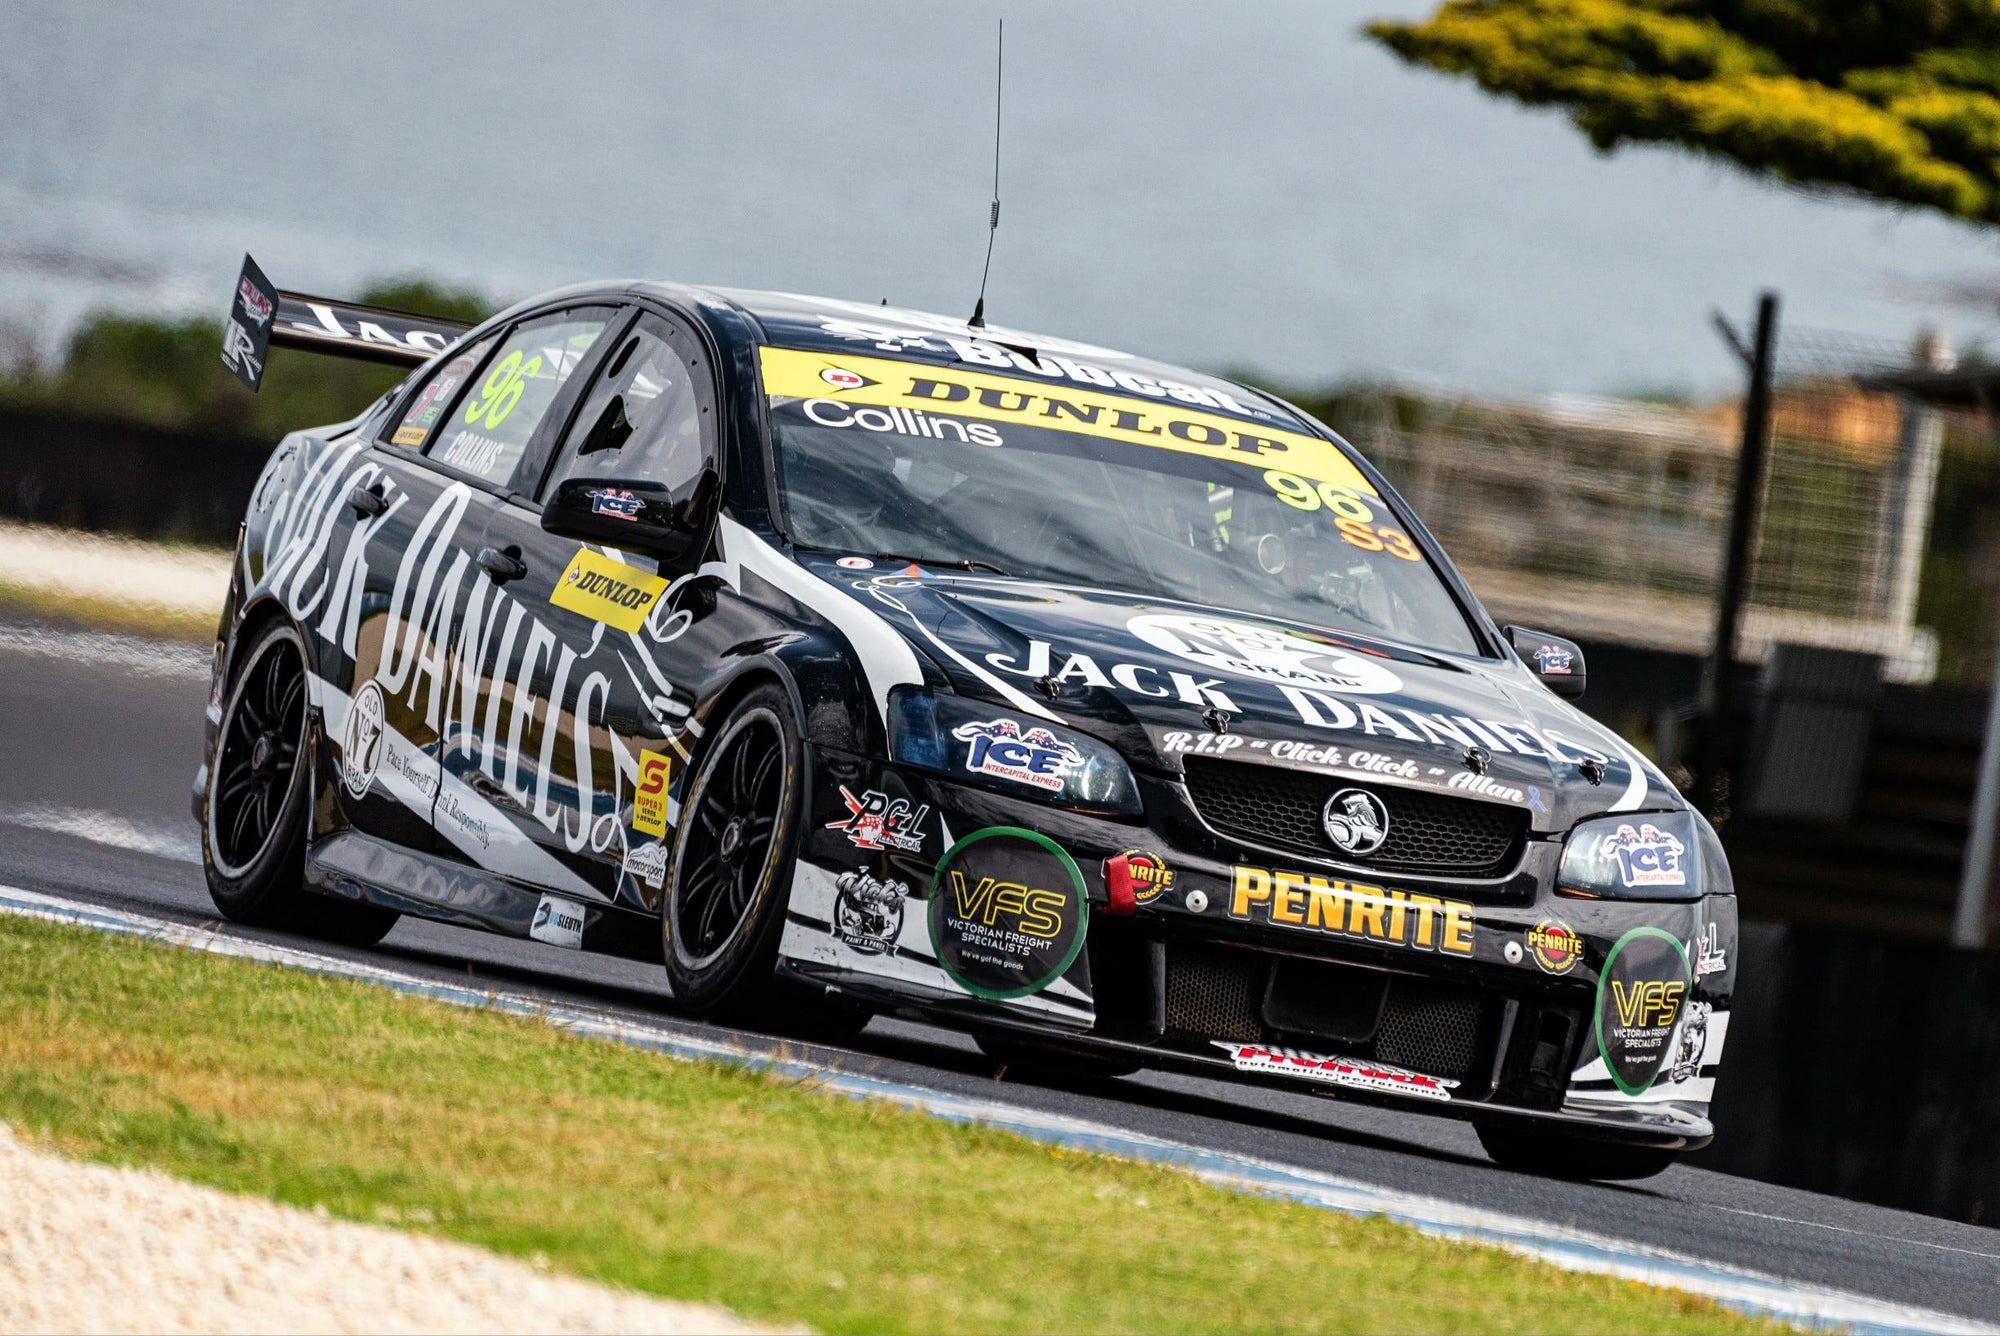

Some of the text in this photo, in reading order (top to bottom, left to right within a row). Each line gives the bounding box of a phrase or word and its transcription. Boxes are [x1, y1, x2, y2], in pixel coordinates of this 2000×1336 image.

[292, 303, 458, 354] JAC
[465, 350, 542, 430] 96
[803, 400, 1003, 446] Collins
[902, 377, 1289, 456] DUNLOP
[443, 430, 504, 475] COLLINS
[594, 495, 638, 514] ICE
[1263, 469, 1373, 523] 96
[1334, 516, 1422, 562] S3
[576, 571, 652, 610] DUNLOP
[986, 640, 1242, 713] JACK
[1540, 655, 1568, 673] ICE
[365, 695, 378, 716] OLD
[387, 744, 401, 771] Pace
[970, 735, 1063, 773] ICE
[1270, 740, 1342, 766] Click
[1348, 752, 1419, 778] Click
[1448, 772, 1524, 802] Allan
[985, 763, 1061, 788] INTERCAPITAL EXPRESS
[1618, 846, 1675, 882] ICE
[951, 870, 1066, 938] VFS
[1233, 866, 1473, 952] PENRITE
[844, 936, 863, 946] PAINT
[869, 940, 886, 950] PANEL
[947, 918, 1052, 951] VICTORIAN FREIGHT
[961, 932, 1031, 956] SPECIALISTS
[1528, 931, 1583, 955] PENRITE
[981, 955, 991, 963] got
[992, 957, 1002, 965] the
[1004, 960, 1024, 970] goods
[1612, 981, 1684, 1027] VFS
[1614, 1028, 1650, 1038] VICTORIAN
[1624, 1038, 1662, 1048] SPECIALISTS
[1240, 1060, 1448, 1098] automotive performance
